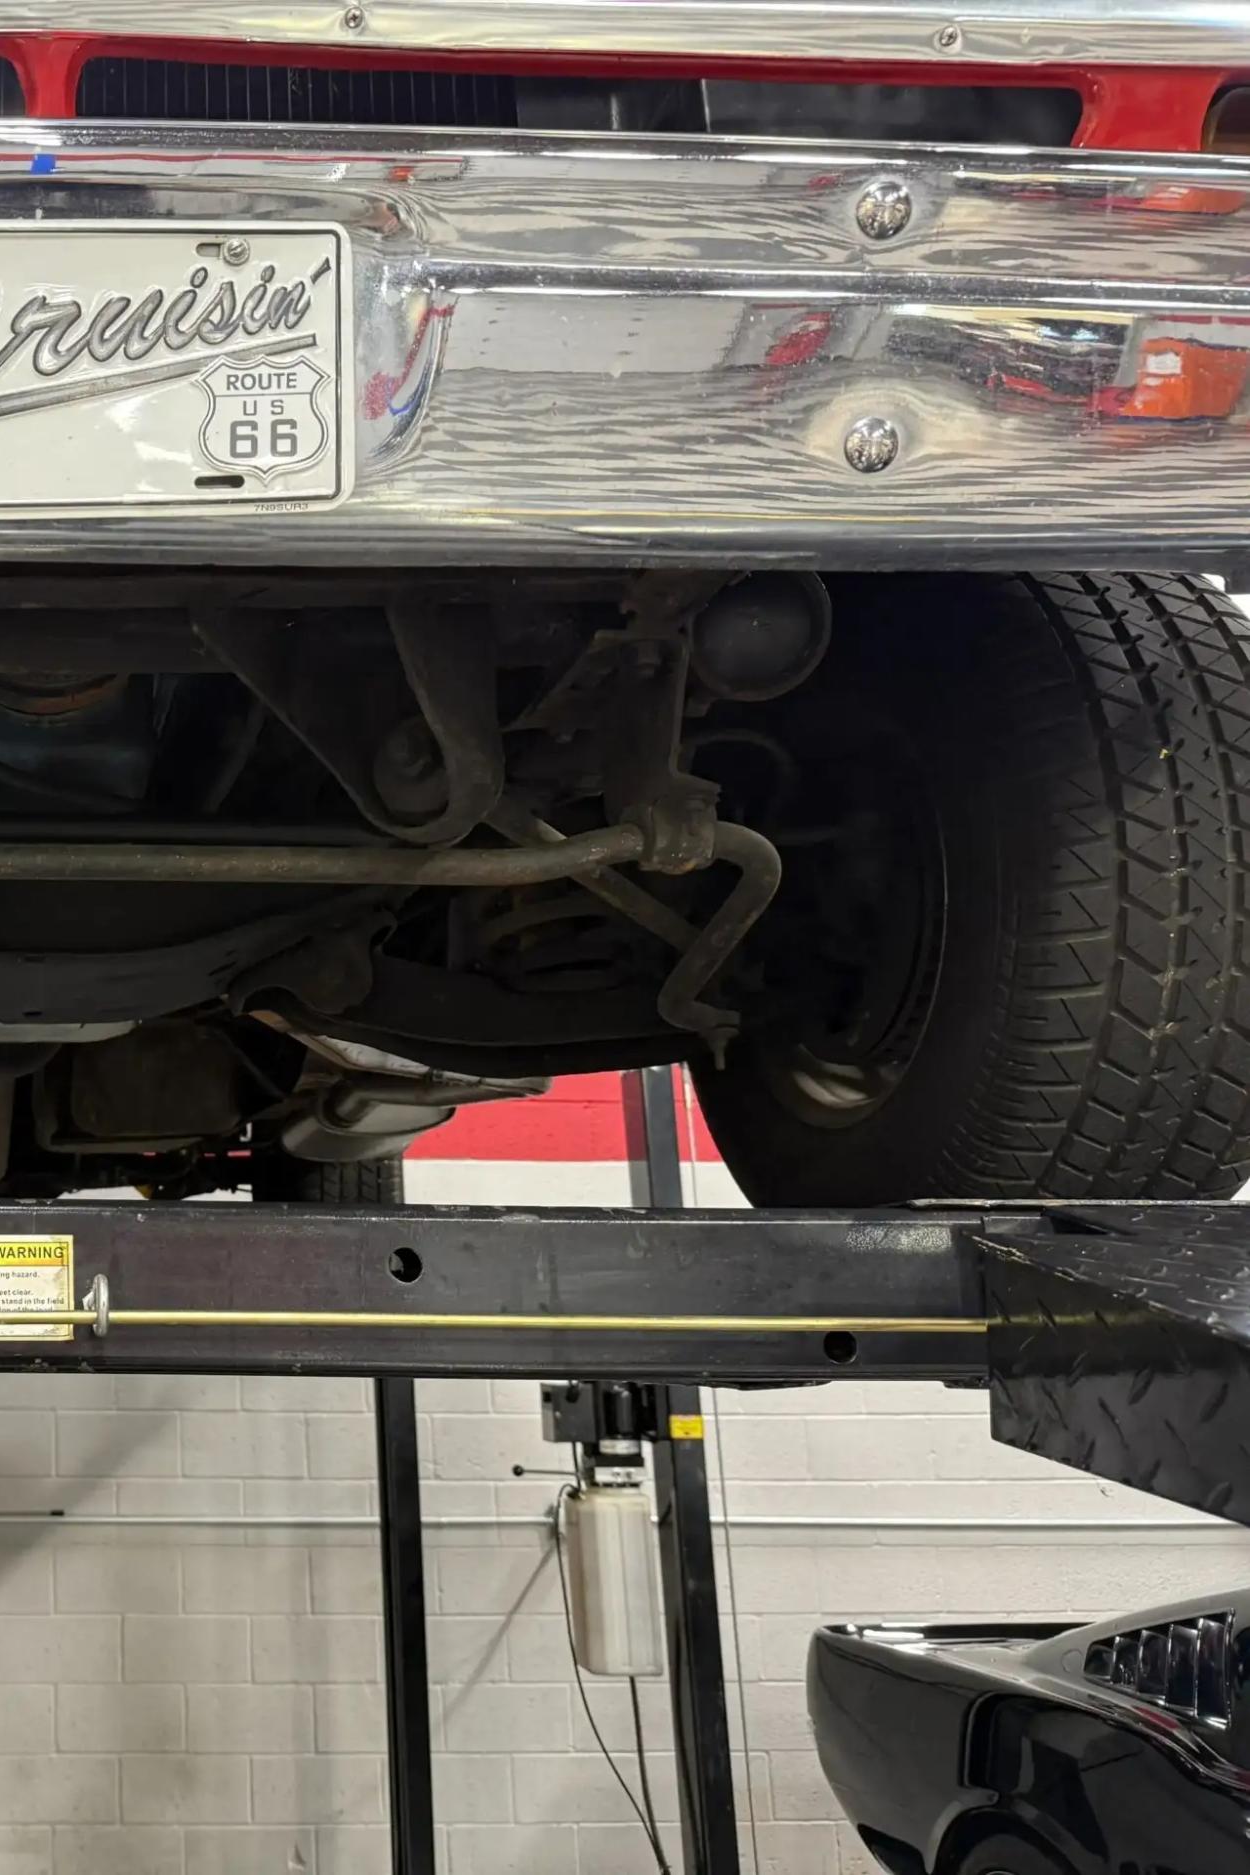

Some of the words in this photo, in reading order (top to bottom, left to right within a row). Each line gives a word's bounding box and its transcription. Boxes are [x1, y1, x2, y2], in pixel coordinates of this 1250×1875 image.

[226, 372, 298, 391] ROUTE
[230, 418, 298, 458] 66
[12, 1288, 34, 1296] clear.
[1, 1297, 23, 1305] stand
[24, 1297, 32, 1305] in
[33, 1297, 46, 1305] the
[47, 1297, 65, 1305] field
